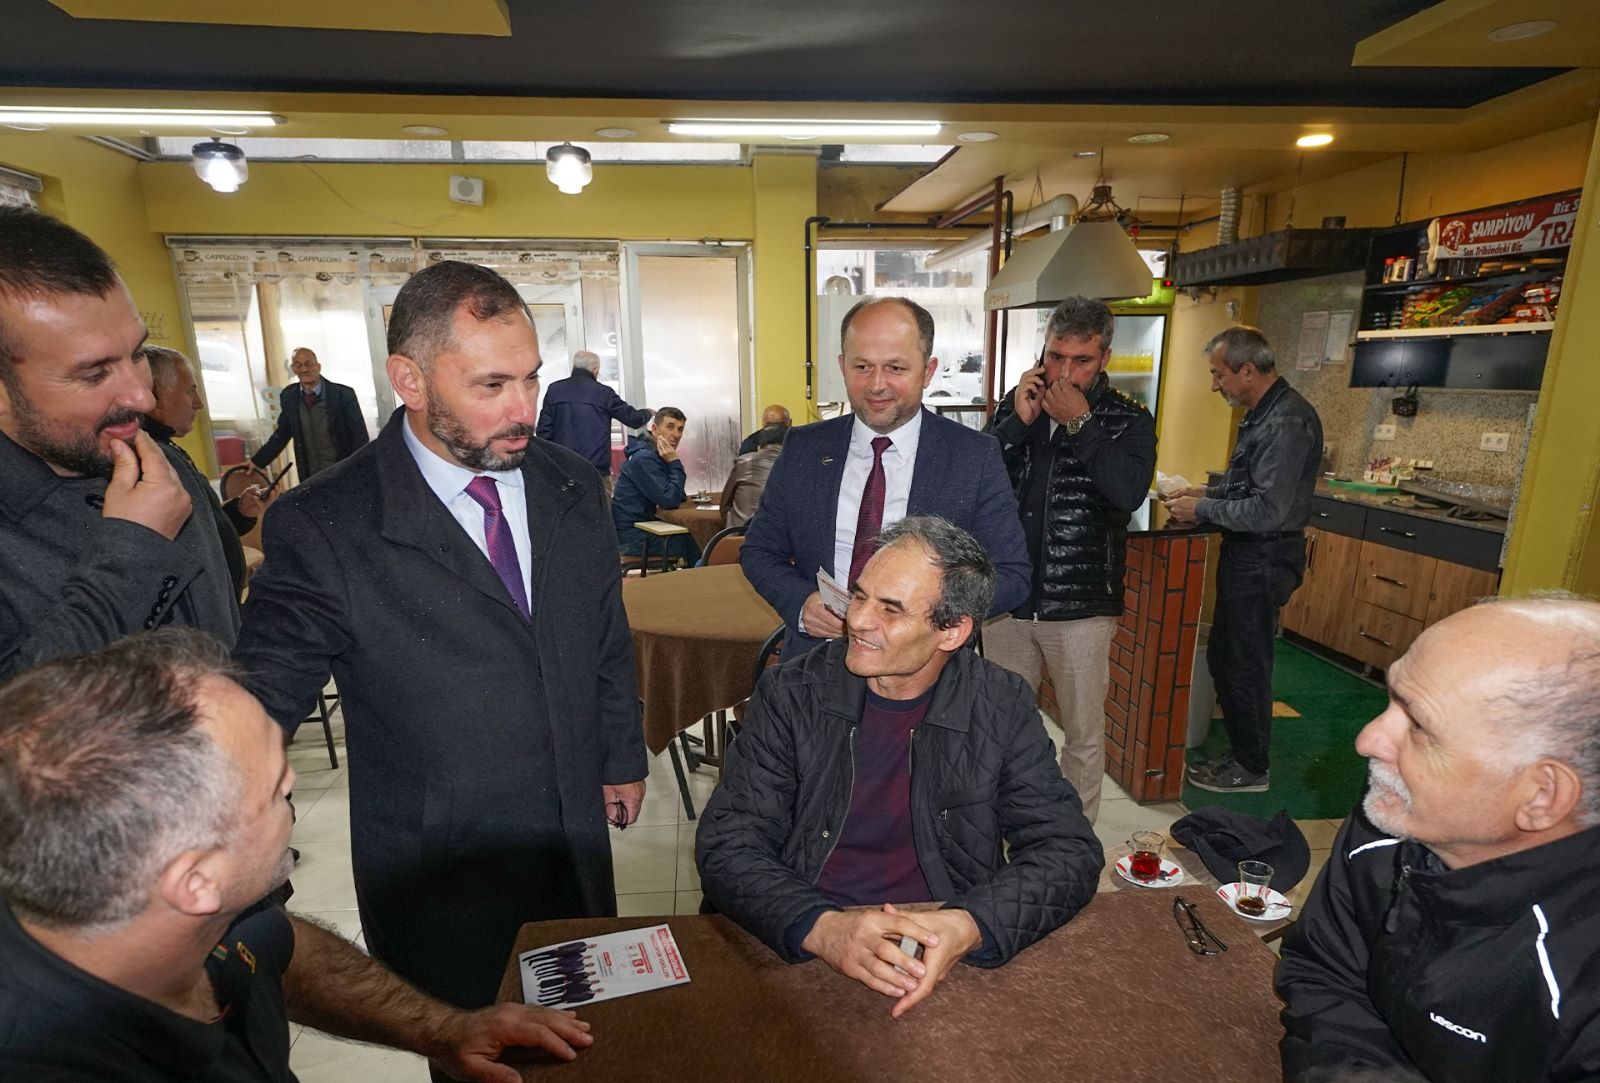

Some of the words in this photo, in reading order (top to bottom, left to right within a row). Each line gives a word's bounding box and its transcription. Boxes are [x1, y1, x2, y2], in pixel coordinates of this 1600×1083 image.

[1553, 203, 1569, 214] Biz
[1469, 212, 1535, 242] ŞAMPİYON
[1511, 240, 1523, 251] Biz
